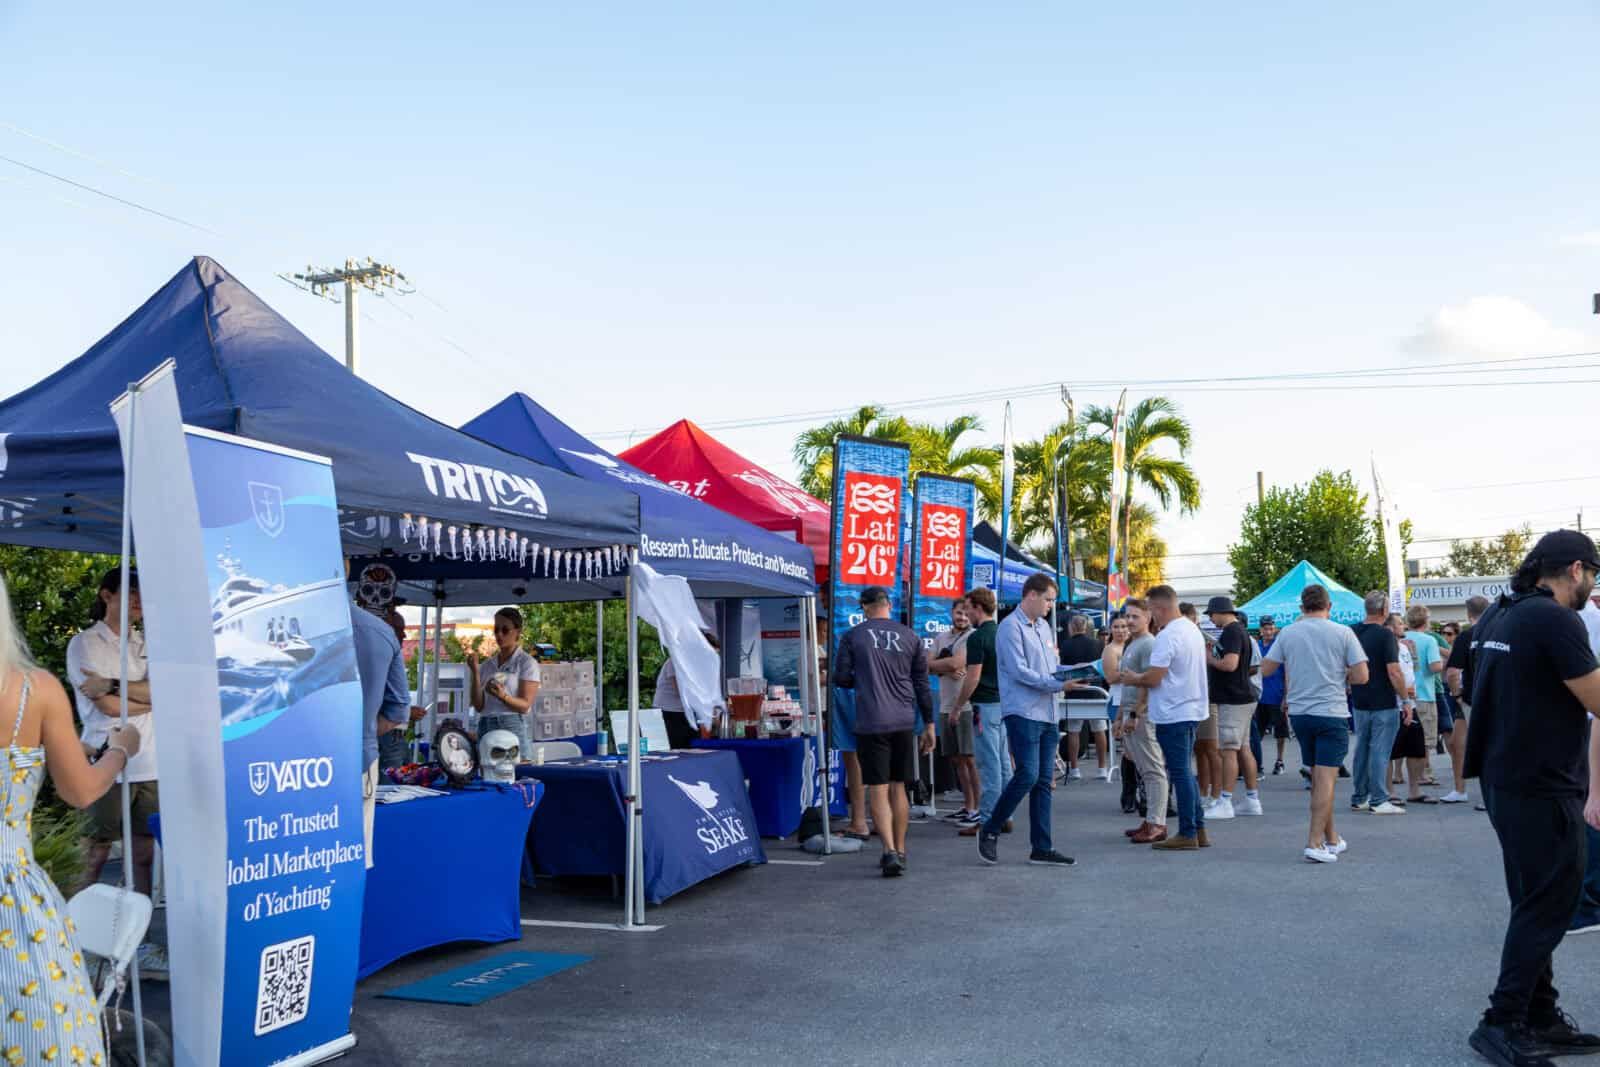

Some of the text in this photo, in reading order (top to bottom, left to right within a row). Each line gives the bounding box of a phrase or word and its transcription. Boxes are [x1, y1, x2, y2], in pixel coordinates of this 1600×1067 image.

[405, 451, 548, 515] TRITON
[849, 514, 896, 542] Lat
[640, 534, 691, 559] Research.
[692, 538, 732, 561] Educate.
[732, 542, 763, 569] Protect
[765, 555, 779, 573] and
[928, 539, 960, 561] Lat
[867, 629, 903, 652] YR
[270, 757, 333, 792] YATCO
[244, 804, 339, 843] The Trusted
[227, 840, 363, 886] lobal Marketplace
[244, 892, 264, 922] of
